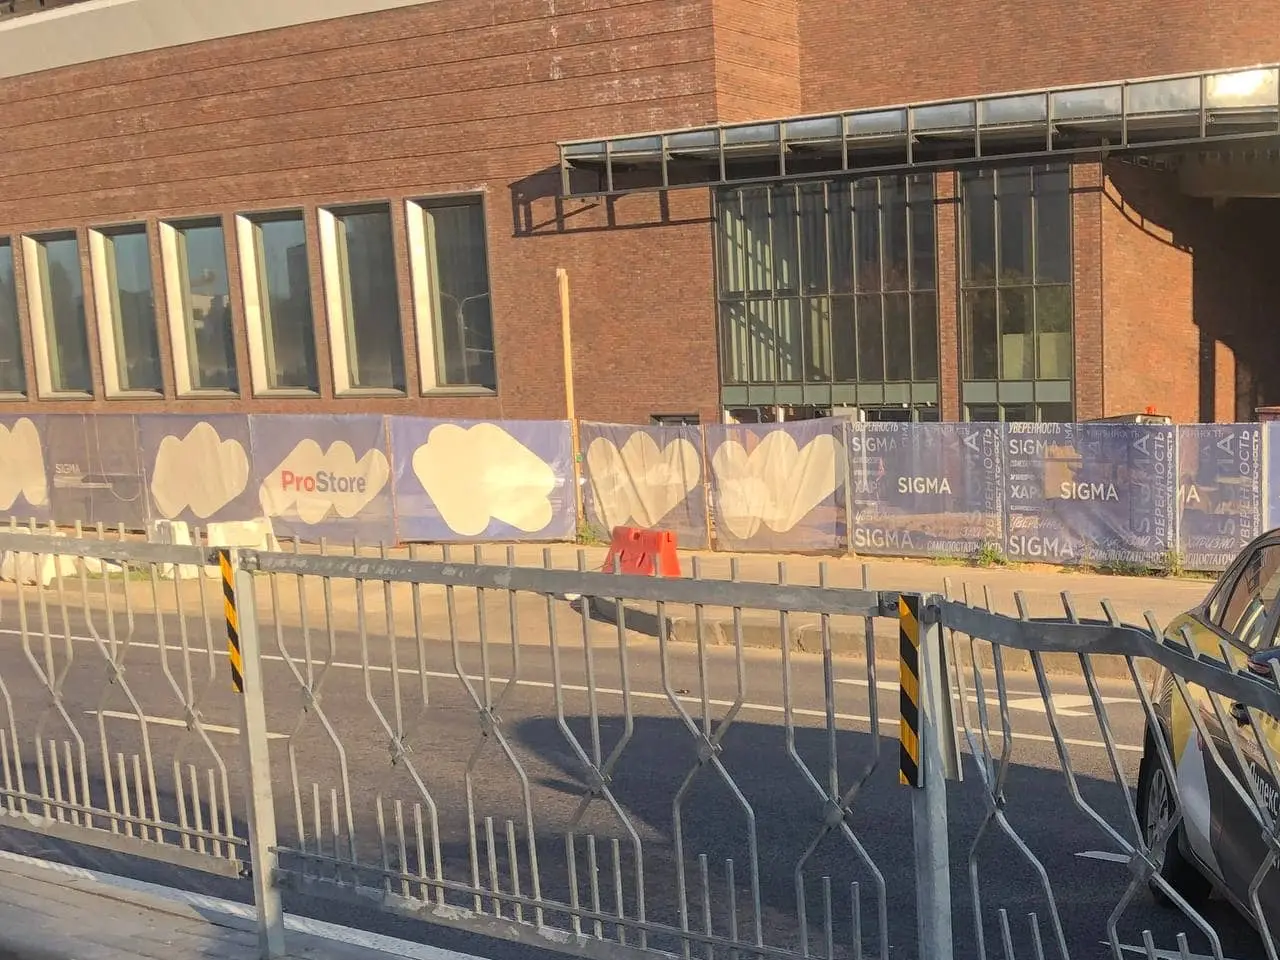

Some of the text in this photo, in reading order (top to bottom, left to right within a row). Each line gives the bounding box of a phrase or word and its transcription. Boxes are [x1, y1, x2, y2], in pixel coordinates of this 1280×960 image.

[1008, 422, 1061, 434] УВЕРЕННОСТЬ
[852, 437, 897, 453] SIGMA
[55, 463, 80, 474] SIGMA
[282, 470, 366, 493] ProStore
[898, 477, 952, 495] SIGMA
[1060, 482, 1119, 501] SIGMA
[854, 529, 914, 549] SIGMA
[1009, 536, 1075, 557] SIGMA
